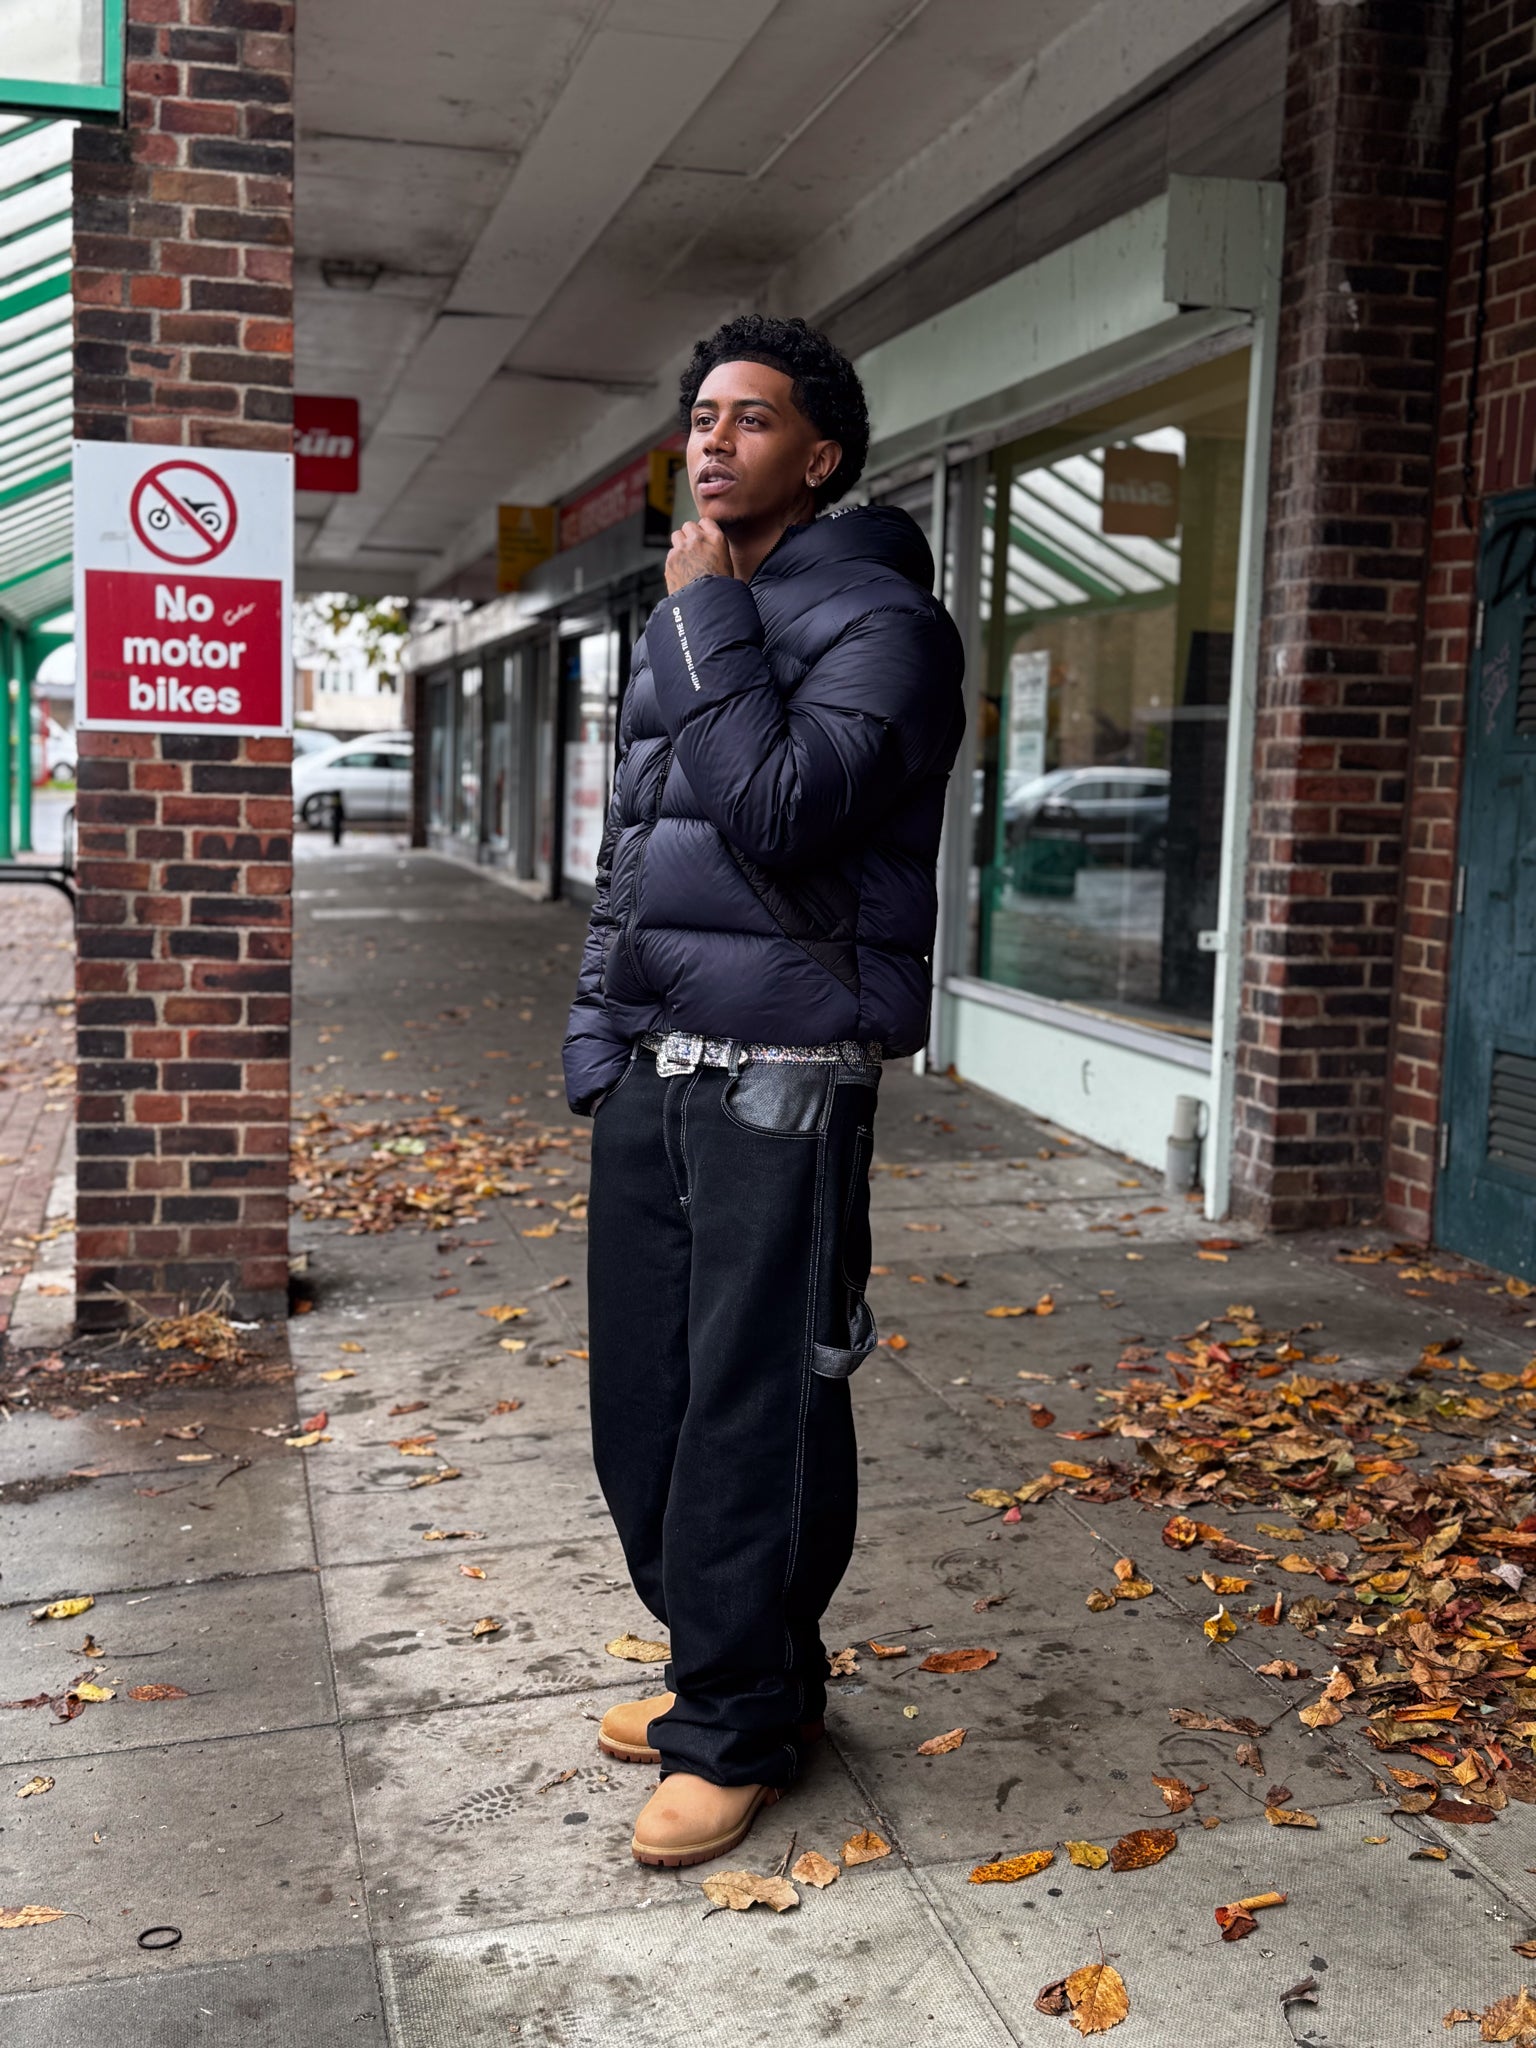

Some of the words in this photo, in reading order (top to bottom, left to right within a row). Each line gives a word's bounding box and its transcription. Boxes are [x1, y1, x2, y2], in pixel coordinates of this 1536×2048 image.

[155, 584, 215, 623] No
[672, 607, 682, 622] END
[676, 622, 685, 637] THE
[123, 633, 247, 669] motor
[680, 636, 689, 651] TILL
[684, 650, 695, 672] THEM
[690, 671, 701, 691] WITH
[129, 675, 242, 715] bikes
